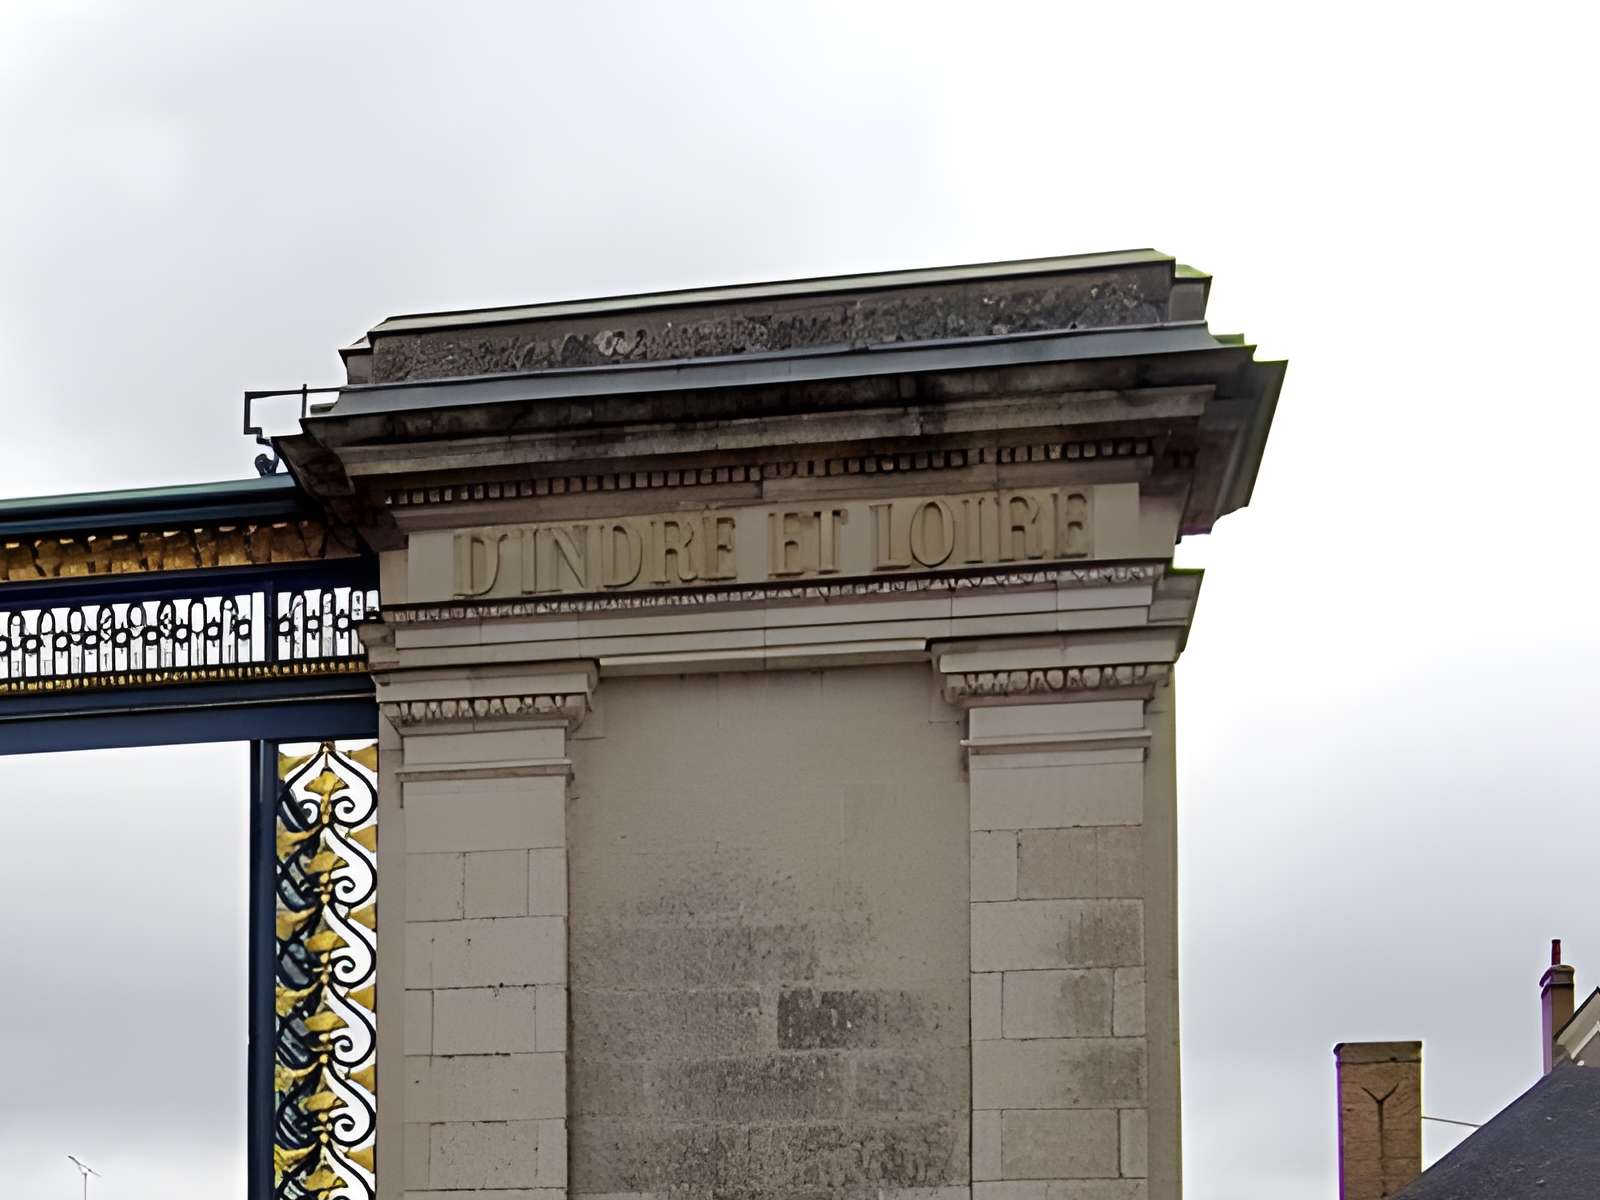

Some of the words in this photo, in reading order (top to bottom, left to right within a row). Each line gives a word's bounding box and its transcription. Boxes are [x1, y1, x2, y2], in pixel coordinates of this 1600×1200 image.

[453, 516, 737, 597] D'INDRE
[768, 509, 848, 577] ET
[869, 486, 1094, 571] LOIRE
